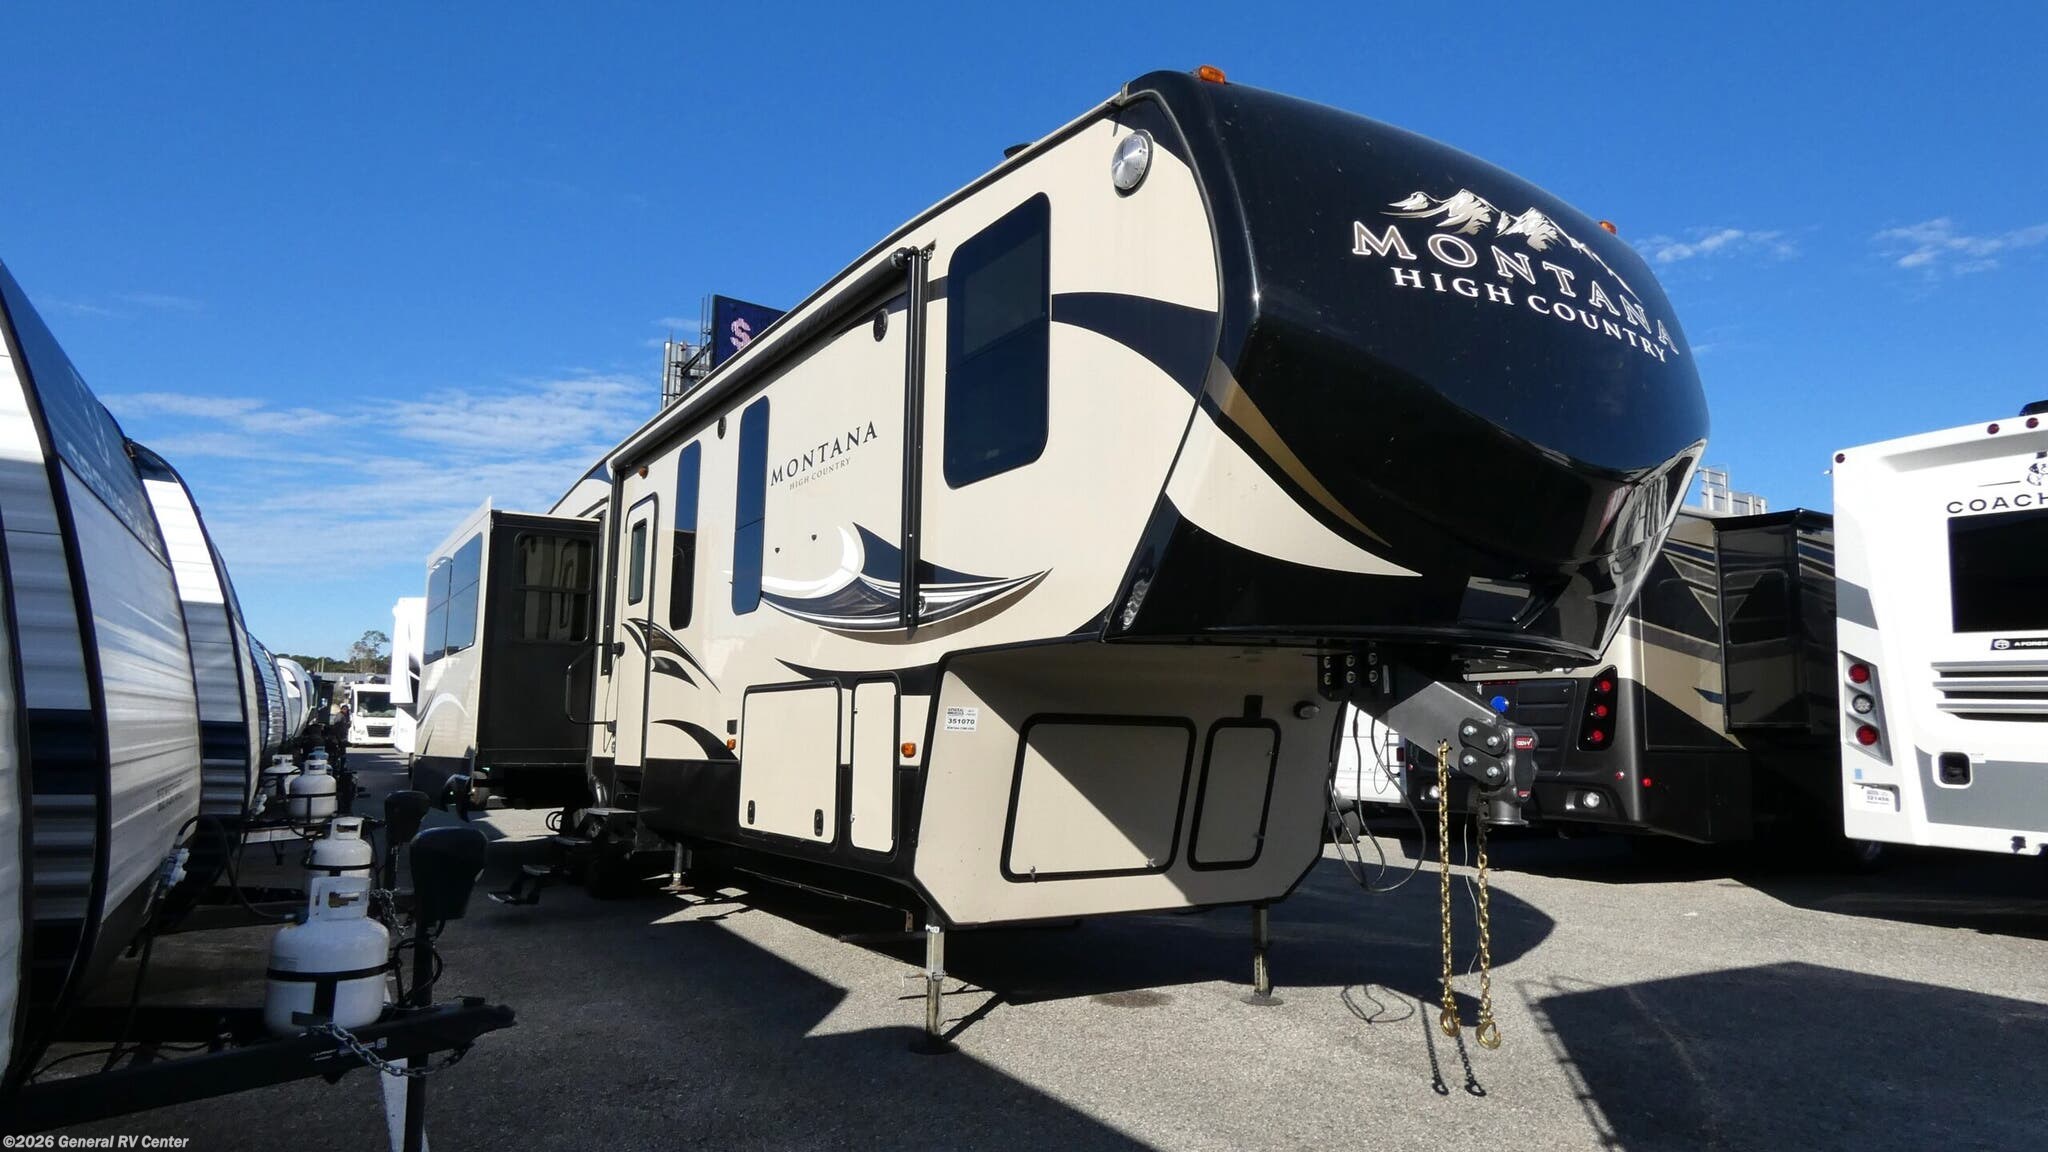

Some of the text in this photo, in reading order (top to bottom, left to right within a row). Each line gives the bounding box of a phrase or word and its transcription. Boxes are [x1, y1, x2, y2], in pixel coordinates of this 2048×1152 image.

[1352, 221, 1680, 355] MONTANA
[1390, 267, 1667, 363] HIGH COUNTRY
[770, 420, 878, 486] MONTANA
[789, 457, 851, 491] HIGH COUNTRY
